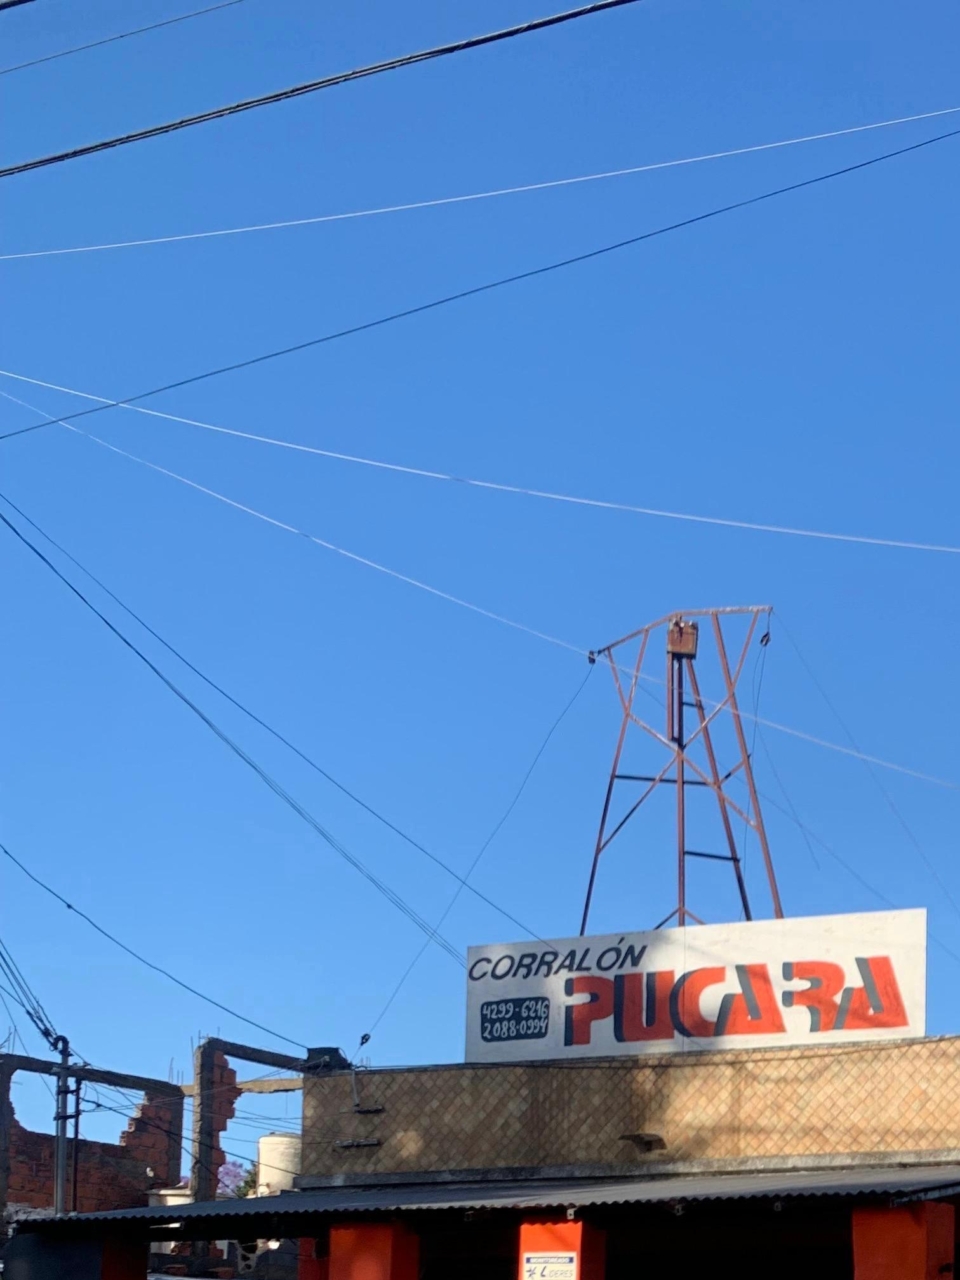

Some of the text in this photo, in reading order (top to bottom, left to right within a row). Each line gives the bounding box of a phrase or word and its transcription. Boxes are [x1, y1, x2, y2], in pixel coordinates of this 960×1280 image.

[468, 937, 648, 981] CORRALÓN
[482, 1000, 549, 1019] 4299-6216
[564, 955, 910, 1047] PUCARA
